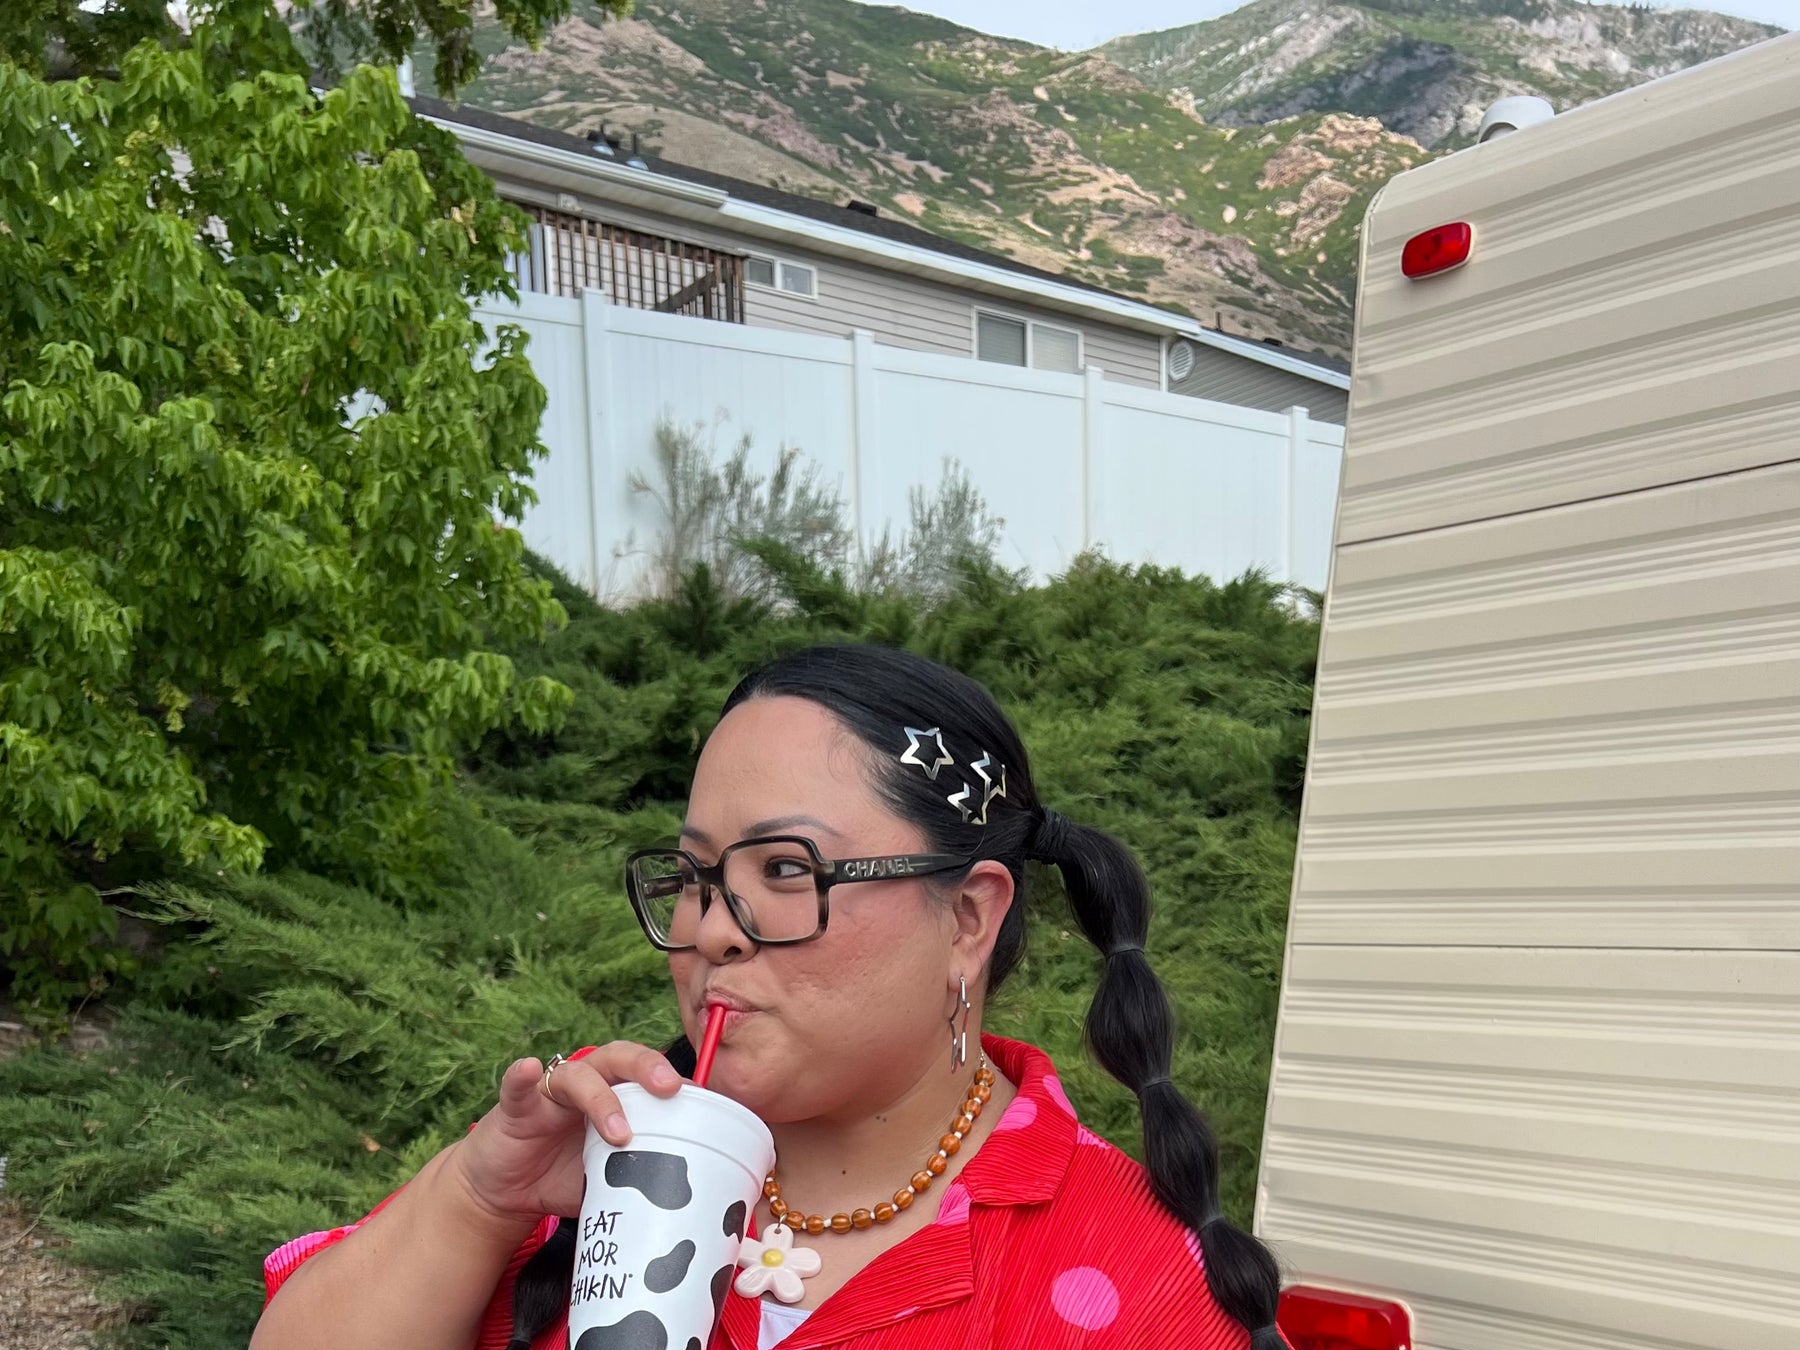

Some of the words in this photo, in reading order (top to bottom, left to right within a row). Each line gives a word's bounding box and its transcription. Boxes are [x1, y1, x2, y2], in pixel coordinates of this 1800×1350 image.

[844, 858, 914, 878] CHANEL
[583, 1210, 624, 1242] EAT
[577, 1239, 619, 1275] MOR
